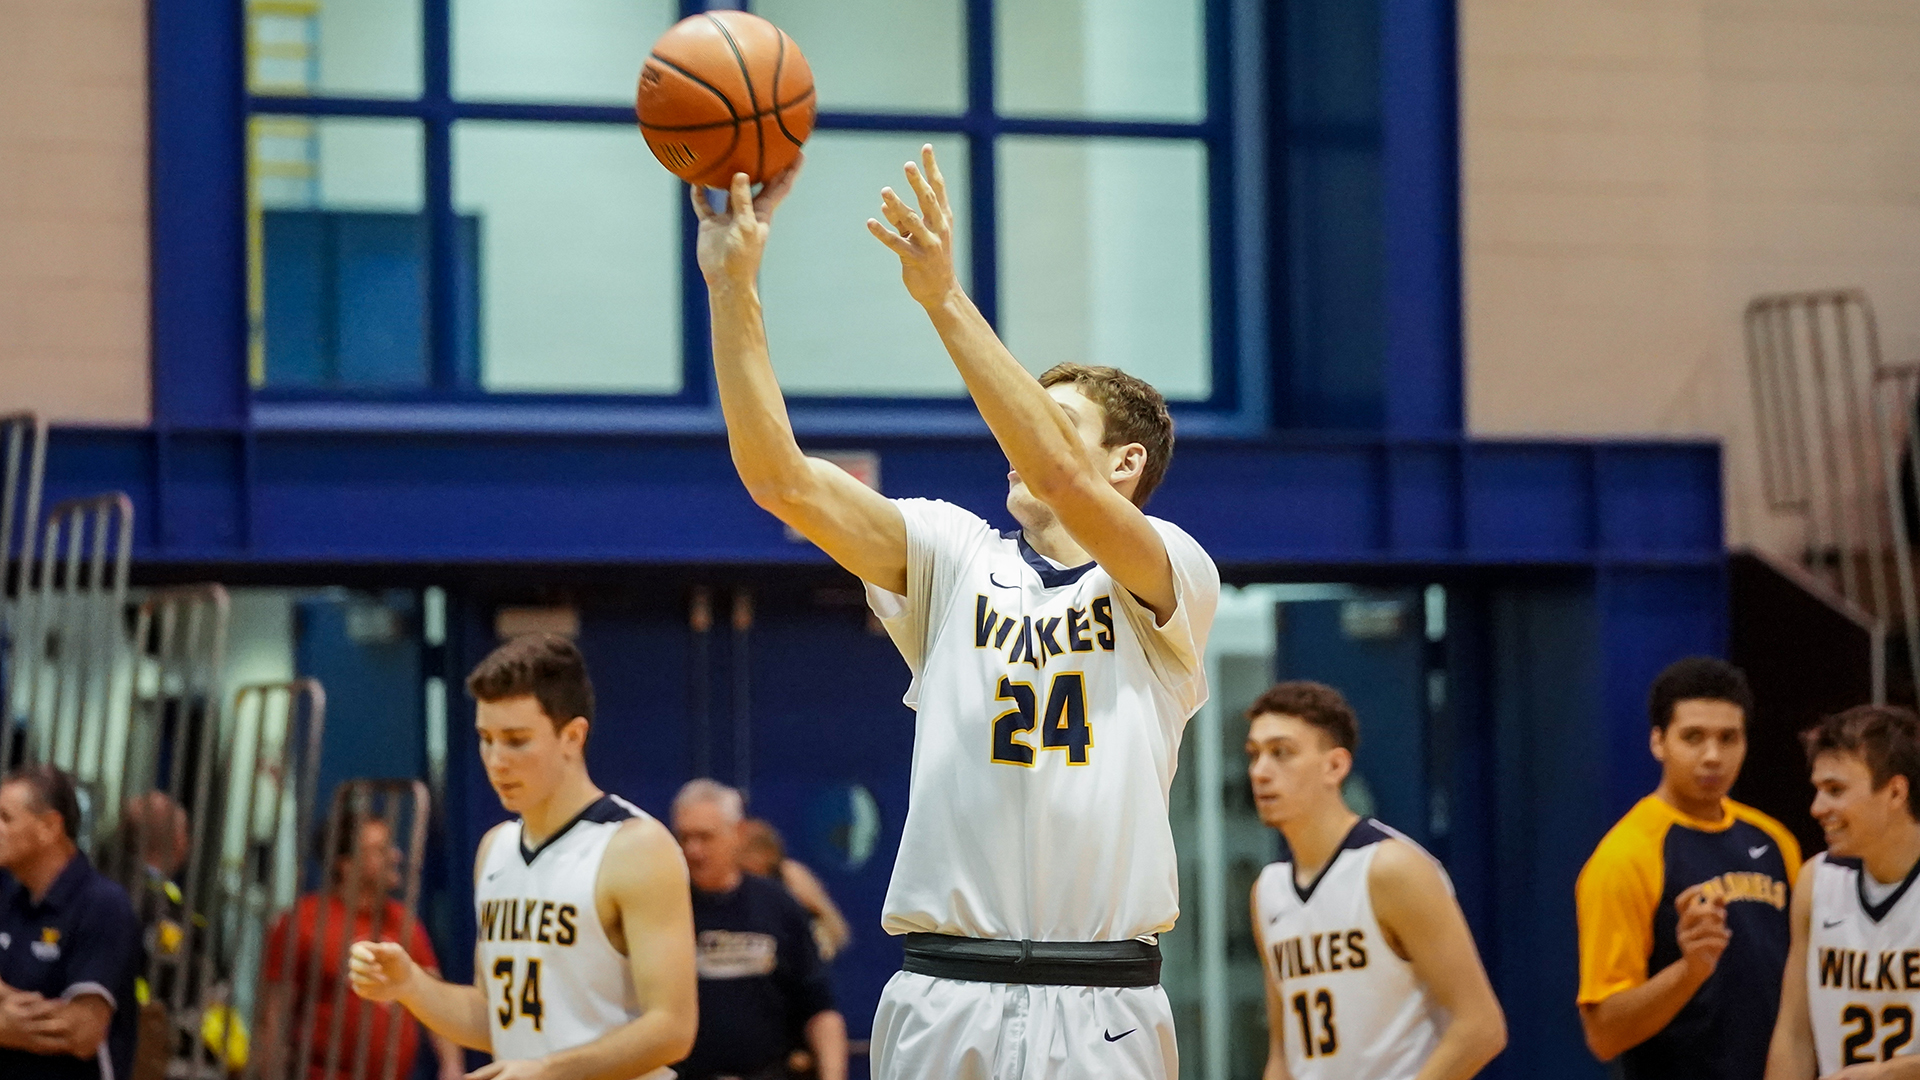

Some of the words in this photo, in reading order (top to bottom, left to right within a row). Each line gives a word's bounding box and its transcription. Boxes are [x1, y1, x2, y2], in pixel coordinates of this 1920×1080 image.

[975, 593, 1115, 670] WILKES
[990, 671, 1094, 767] 24
[481, 898, 578, 947] WILKES
[493, 956, 544, 1031] 34
[1292, 988, 1338, 1059] 13
[1840, 1002, 1914, 1068] 22
